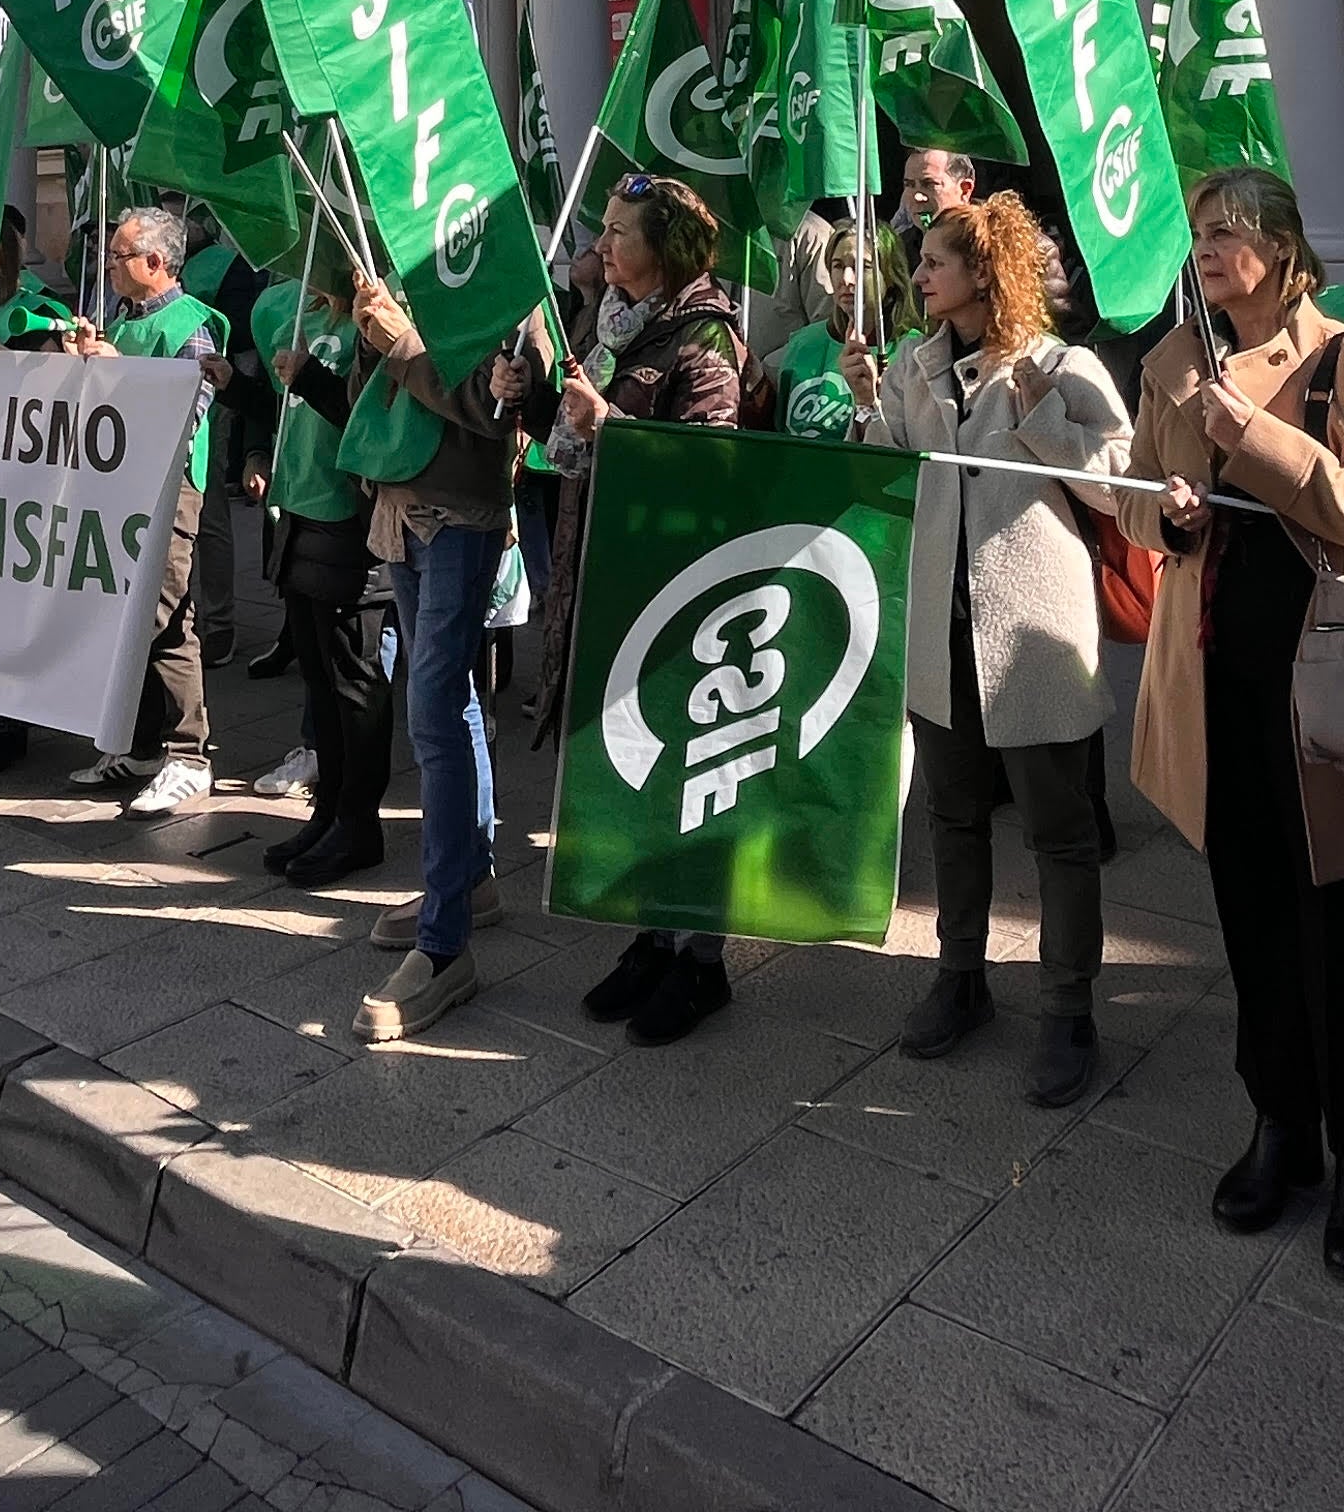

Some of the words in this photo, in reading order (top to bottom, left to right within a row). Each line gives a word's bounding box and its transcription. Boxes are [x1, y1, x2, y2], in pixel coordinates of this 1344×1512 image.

[1100, 128, 1142, 200] CSIF
[446, 195, 490, 258] CSIF
[680, 584, 792, 834] CSIF
